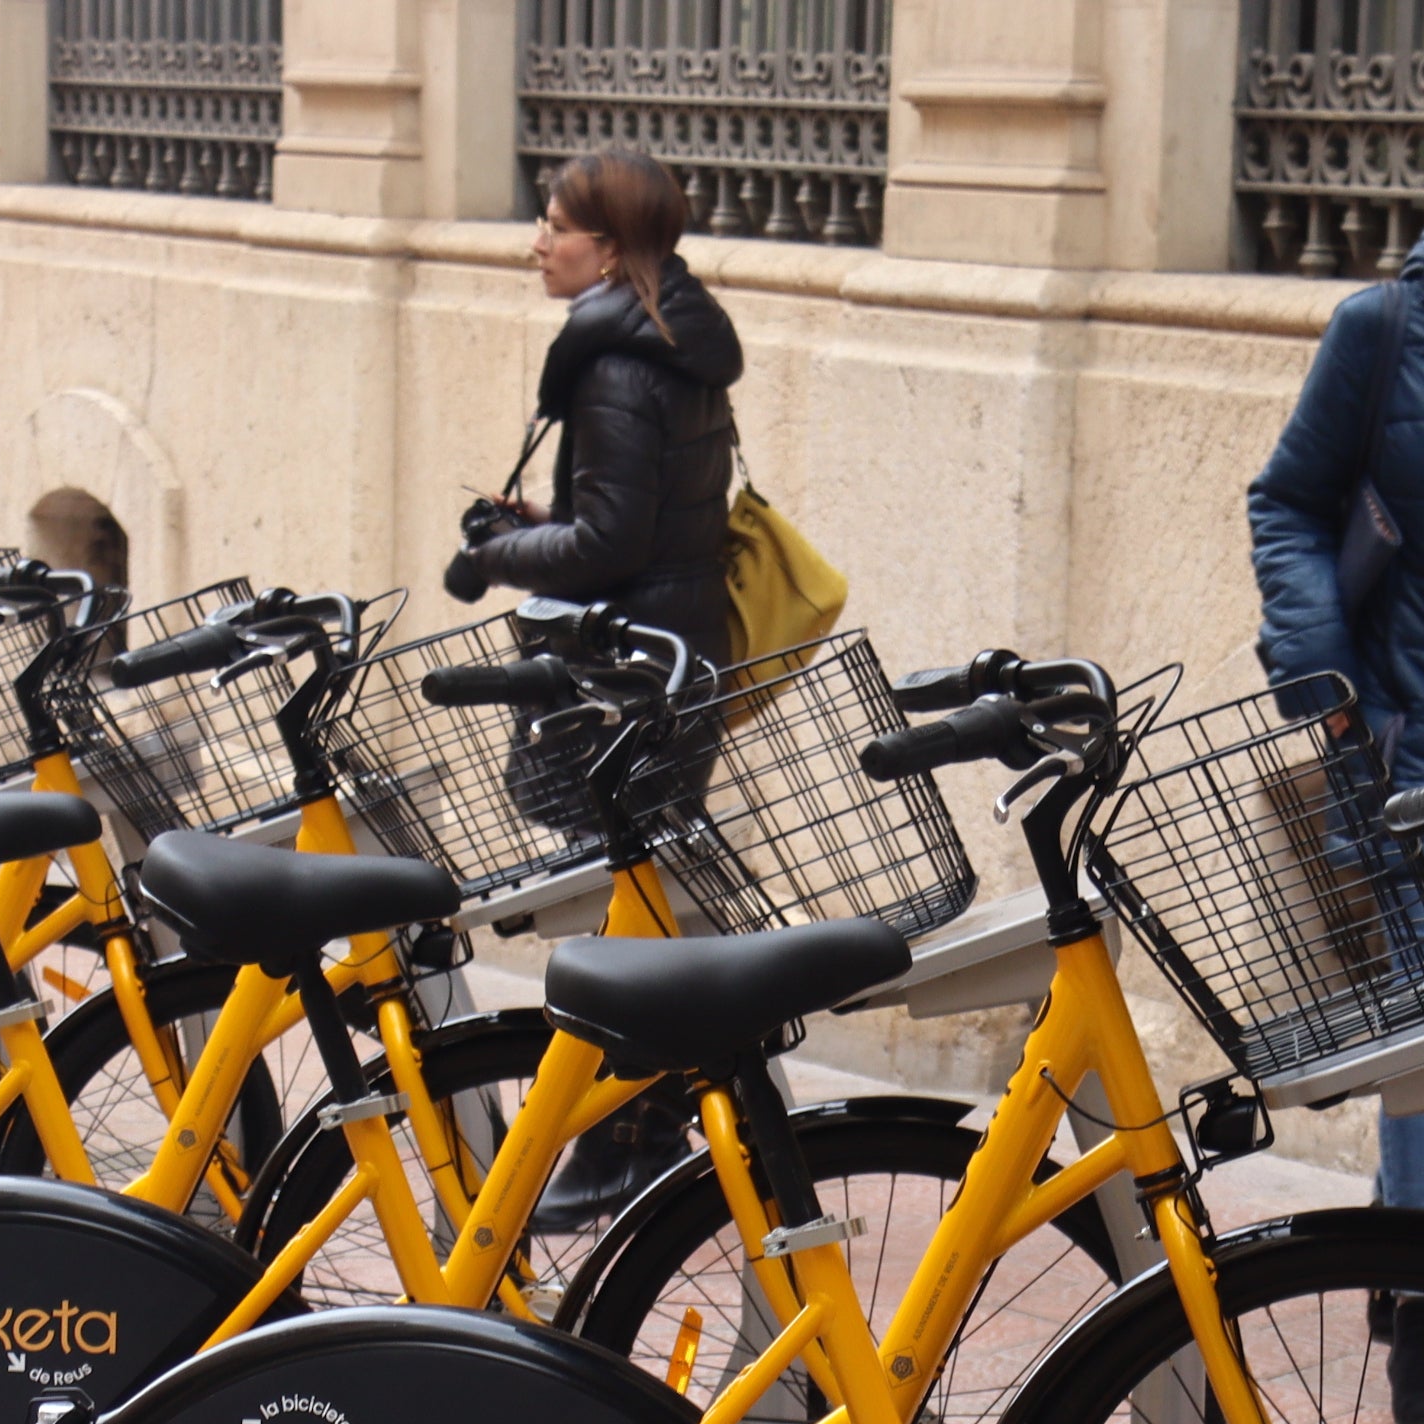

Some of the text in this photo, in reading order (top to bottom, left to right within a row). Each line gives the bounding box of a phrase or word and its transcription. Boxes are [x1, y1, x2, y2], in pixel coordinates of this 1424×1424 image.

[29, 1362, 93, 1386] de Reus
[260, 1401, 280, 1420] la
